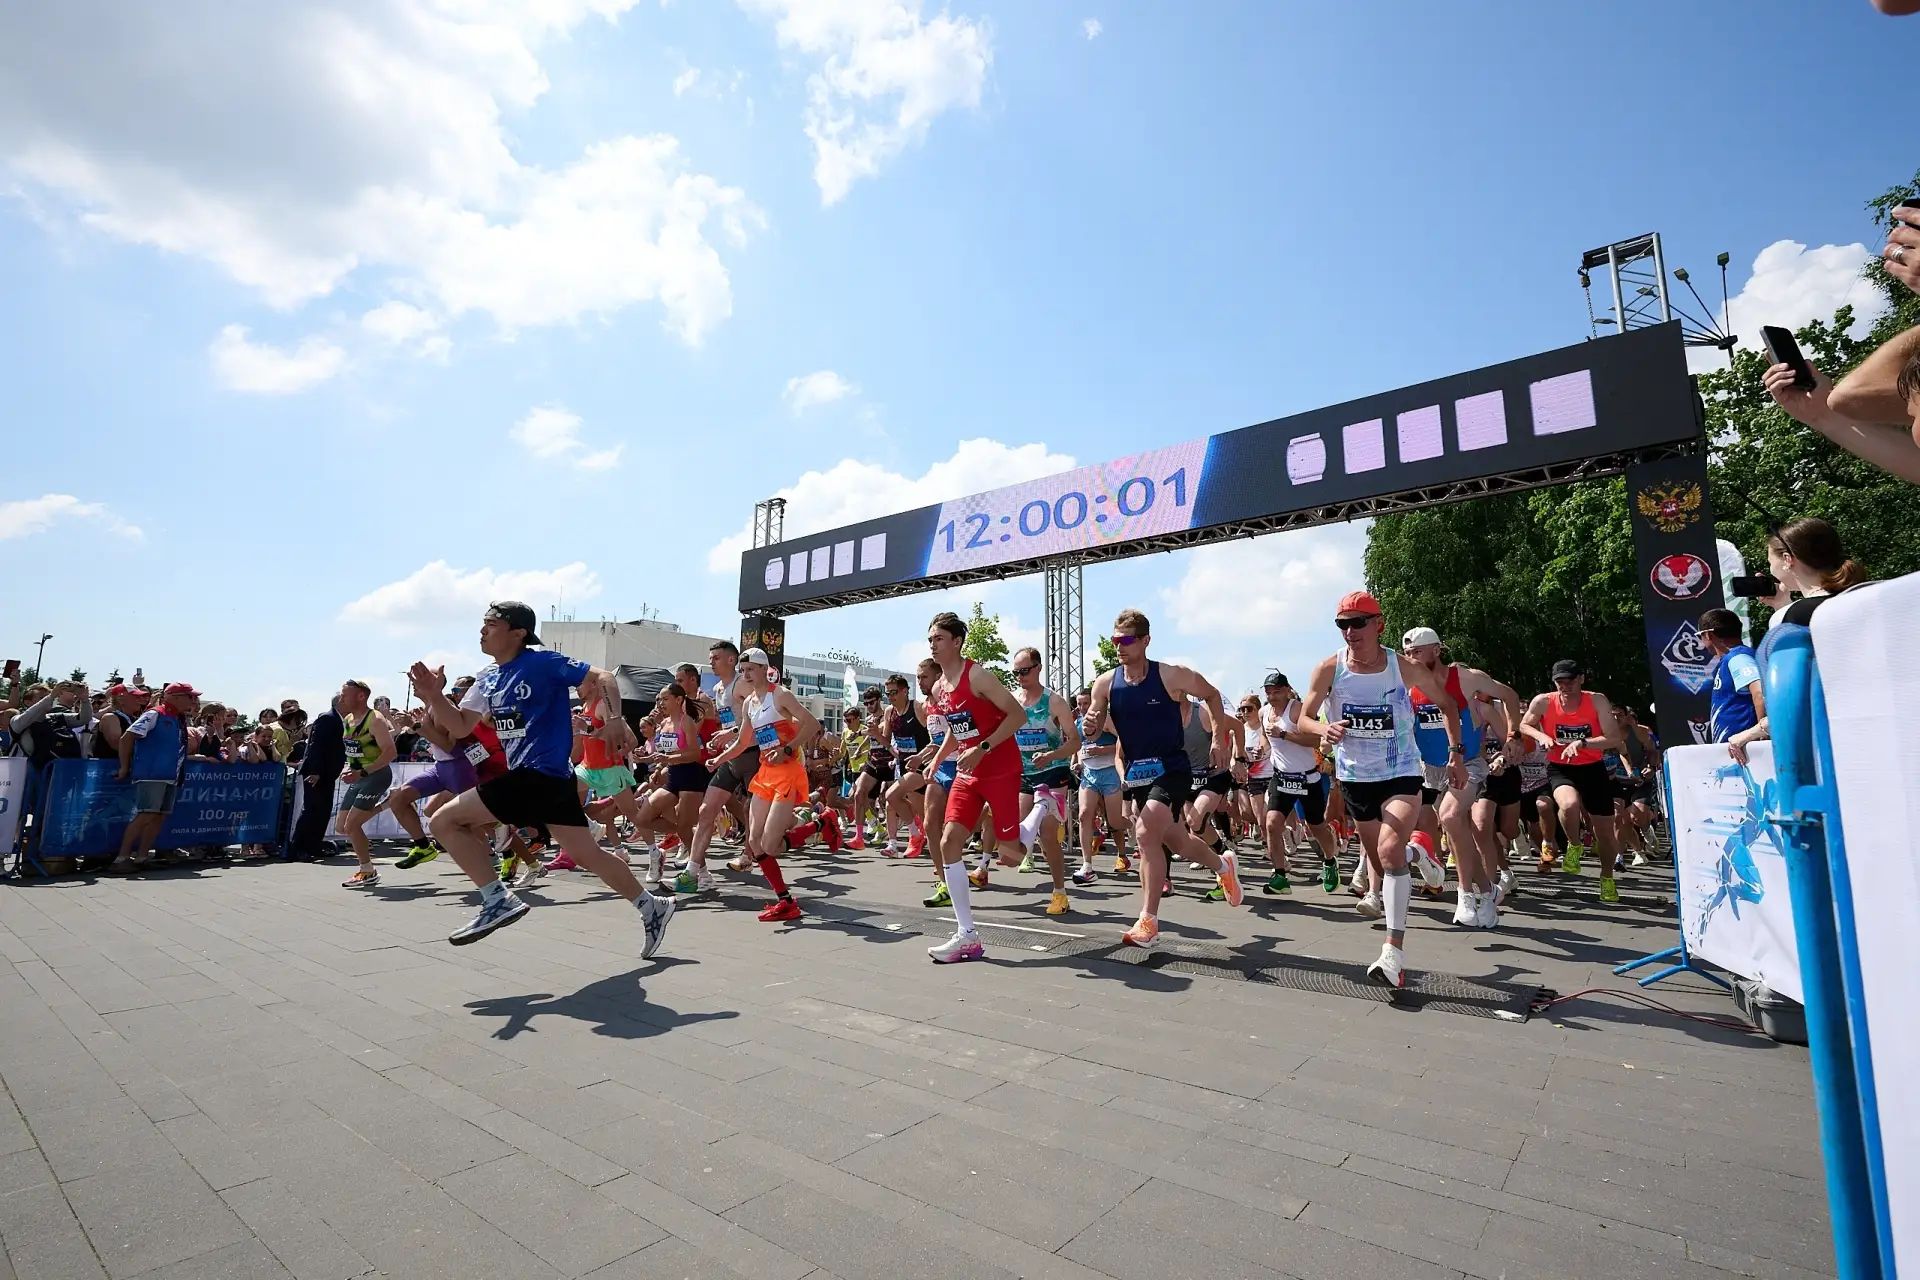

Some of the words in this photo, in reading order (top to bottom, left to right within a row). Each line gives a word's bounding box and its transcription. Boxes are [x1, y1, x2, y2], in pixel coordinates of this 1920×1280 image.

[938, 467, 1187, 553] 12:00:01
[828, 651, 860, 663] COSMOS
[1351, 718, 1384, 730] 1143
[1426, 713, 1444, 723] 115
[950, 721, 970, 734] 1009
[1022, 737, 1042, 746] 3172
[184, 772, 277, 781] DYNAMO-UDM.RU
[1131, 768, 1159, 780] 3228
[1282, 781, 1303, 790] 1082
[177, 786, 275, 803] ДИНАМО
[197, 809, 225, 821] 100
